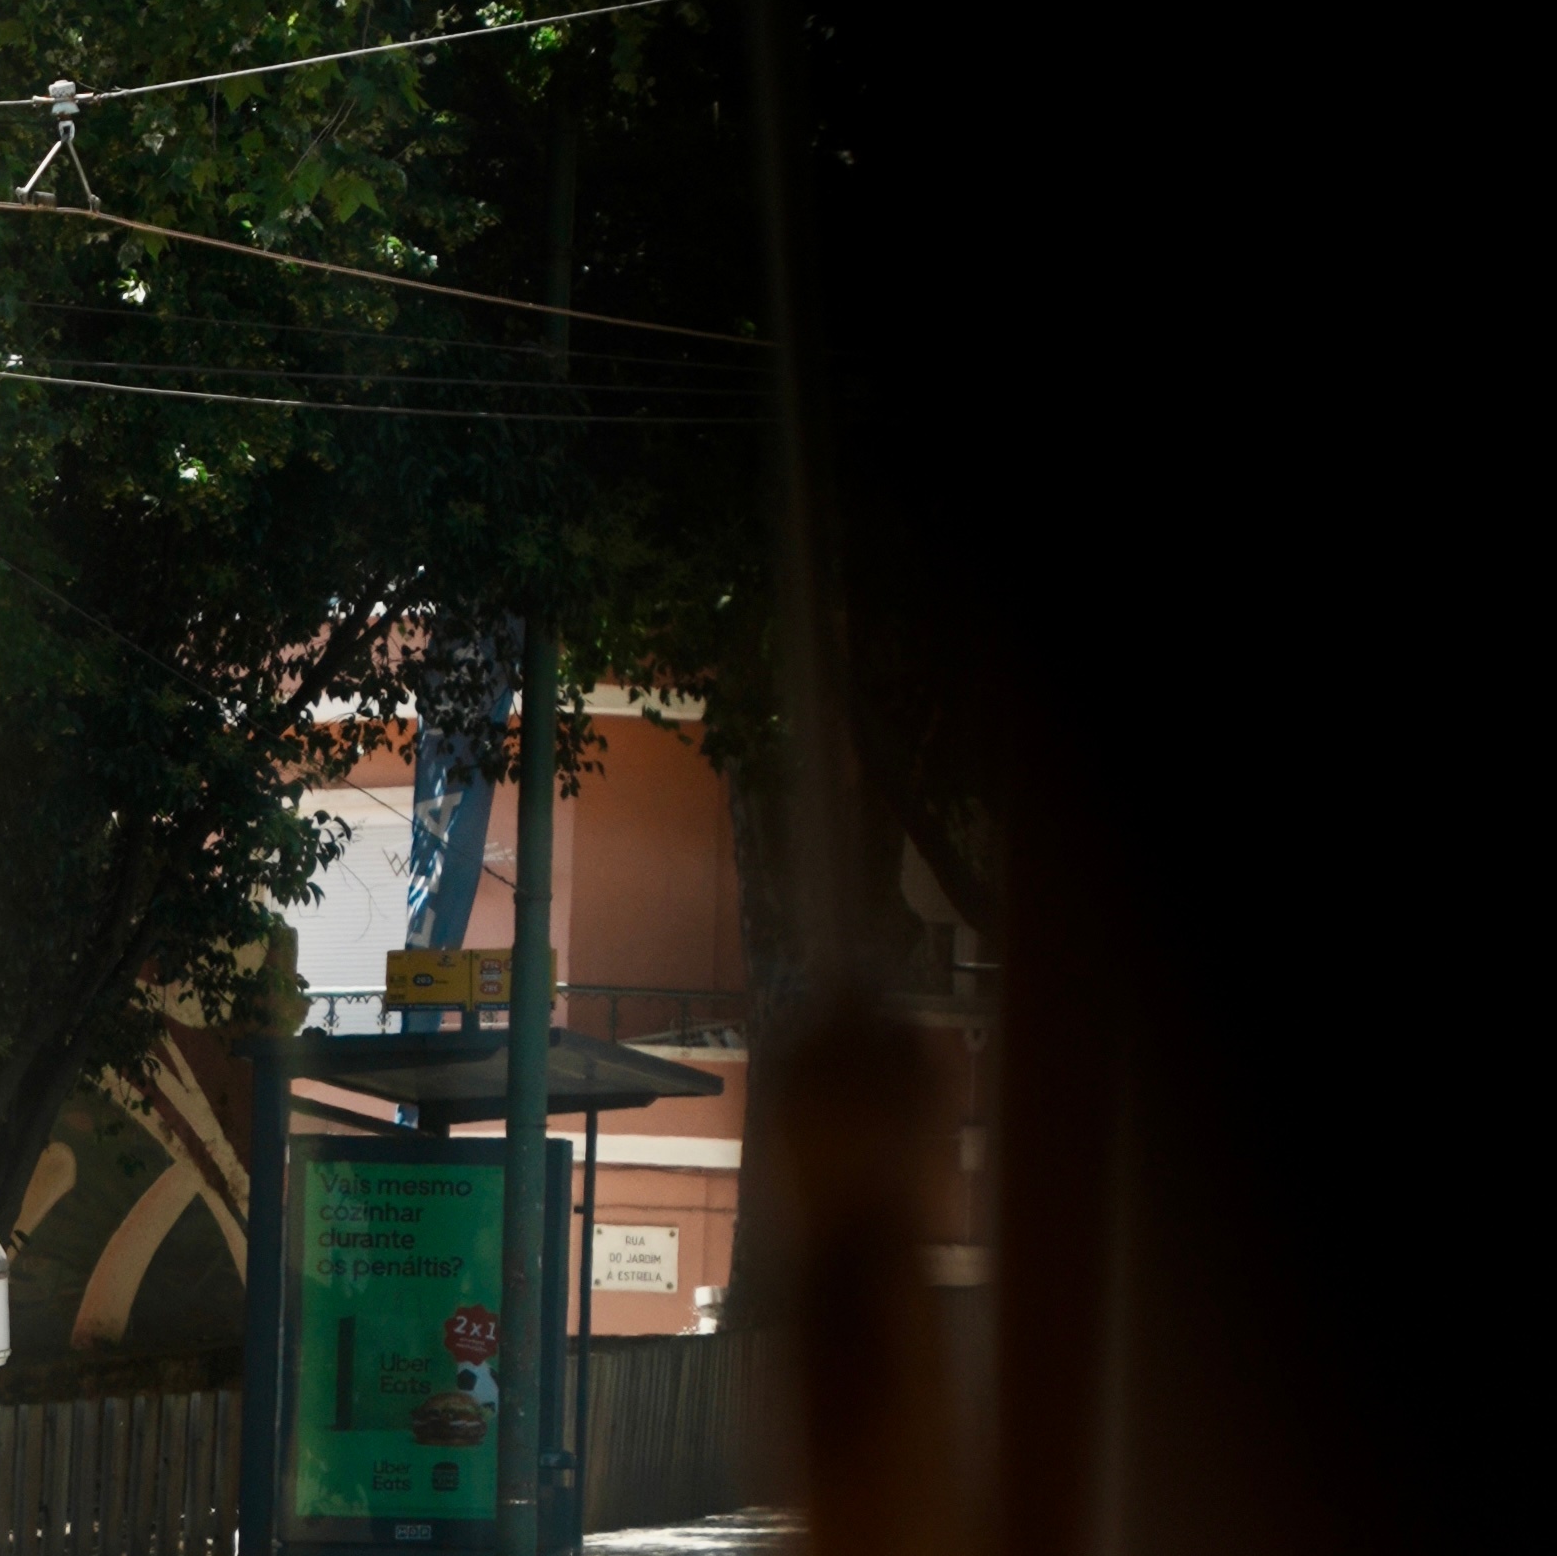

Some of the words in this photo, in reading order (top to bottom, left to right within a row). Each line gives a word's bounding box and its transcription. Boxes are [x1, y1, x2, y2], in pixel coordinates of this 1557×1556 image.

[320, 1173, 371, 1195] Vais
[377, 1179, 473, 1197] mesmo
[319, 1201, 424, 1222] cozinhar
[318, 1228, 416, 1249] durante
[625, 1235, 645, 1246] RUA
[609, 1252, 622, 1264] DO
[626, 1253, 661, 1264] JARDIM
[316, 1259, 348, 1276] os
[352, 1255, 464, 1282] penáltis?
[618, 1270, 663, 1282] ESTRELA
[380, 1352, 432, 1374] Uber
[379, 1375, 432, 1395] Eats
[373, 1459, 412, 1475] Uber
[372, 1476, 412, 1492] Eats
